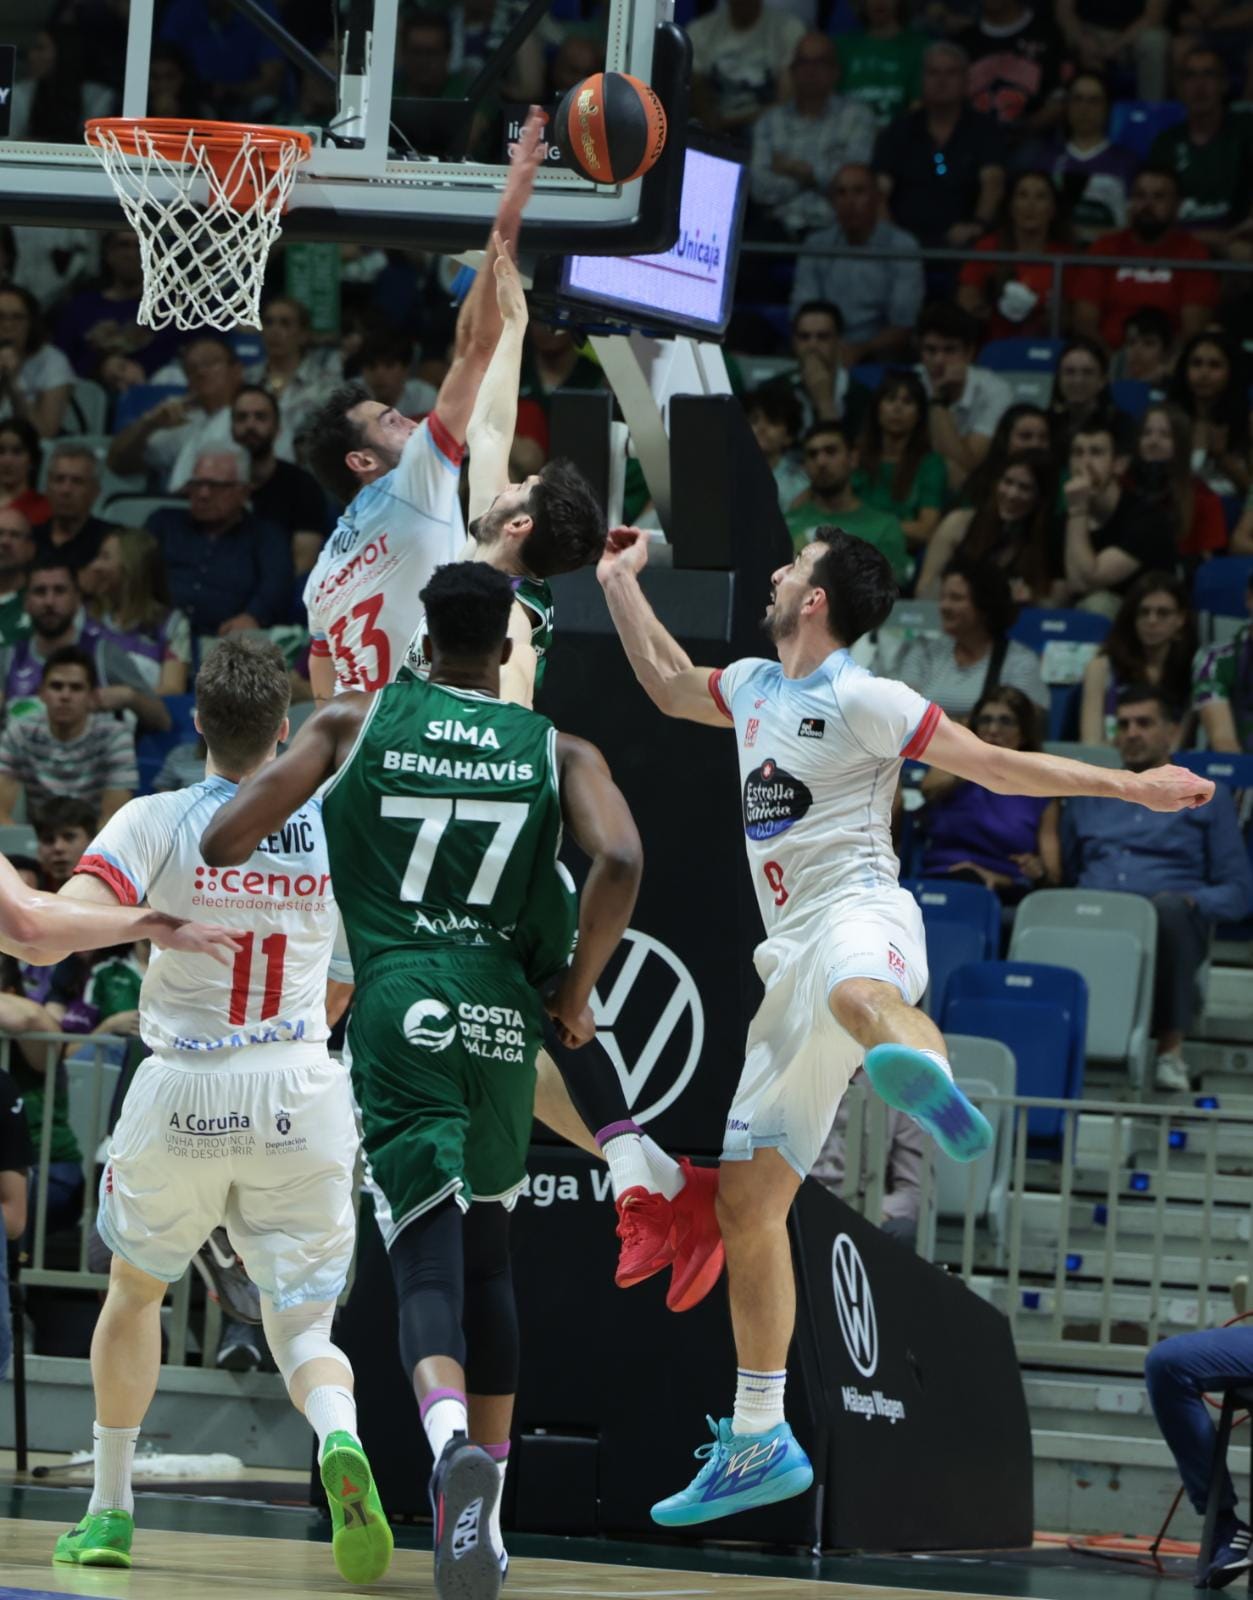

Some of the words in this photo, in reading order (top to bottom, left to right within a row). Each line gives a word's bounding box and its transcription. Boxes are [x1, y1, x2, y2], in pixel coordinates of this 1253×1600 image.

[424, 719, 501, 750] SIMA
[382, 750, 535, 781] BENAHAVÍS
[746, 782, 795, 802] Estrella
[746, 801, 792, 822] Galicia
[380, 795, 531, 906] 77
[221, 869, 331, 897] cenor
[763, 860, 789, 907] 9
[228, 930, 288, 1026] 11
[458, 1001, 526, 1029] COSTA
[459, 1021, 492, 1041] DEL
[495, 1027, 526, 1047] SOL
[169, 1111, 181, 1129] A
[186, 1111, 251, 1131] Coruña
[164, 1132, 195, 1148] UNHA
[196, 1135, 257, 1149] PROVINCIA
[167, 1144, 188, 1158] POR
[871, 1390, 906, 1425] Wagen
